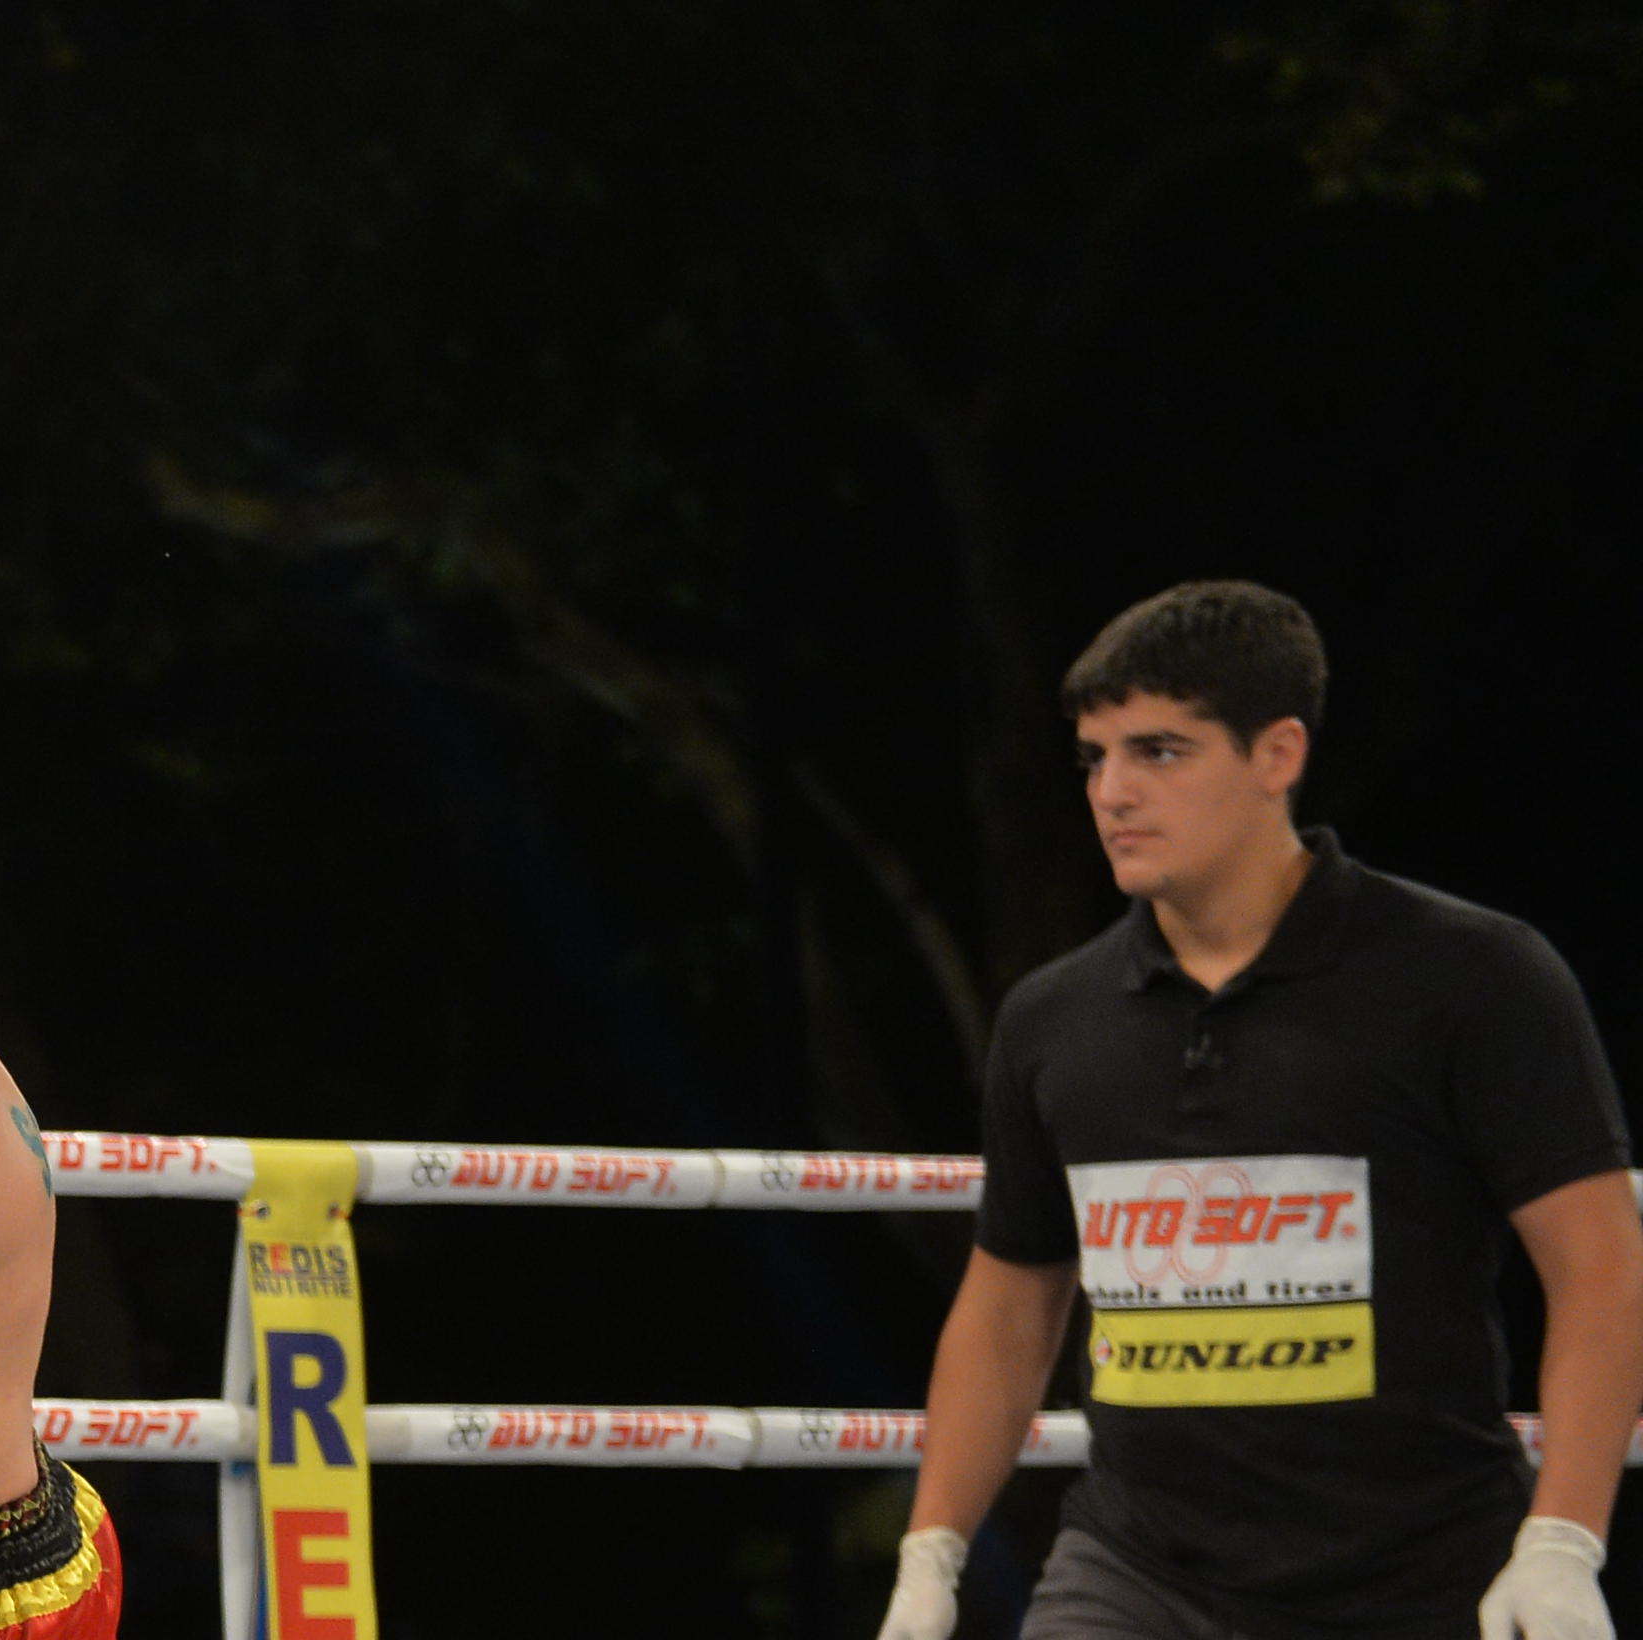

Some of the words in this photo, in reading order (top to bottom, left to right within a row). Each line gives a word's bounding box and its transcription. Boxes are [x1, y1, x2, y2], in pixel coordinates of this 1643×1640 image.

[1084, 1198, 1186, 1249] UTO
[1192, 1193, 1355, 1245] SOFT
[249, 1242, 349, 1277] REDIS
[1118, 1336, 1355, 1372] DUNLOP
